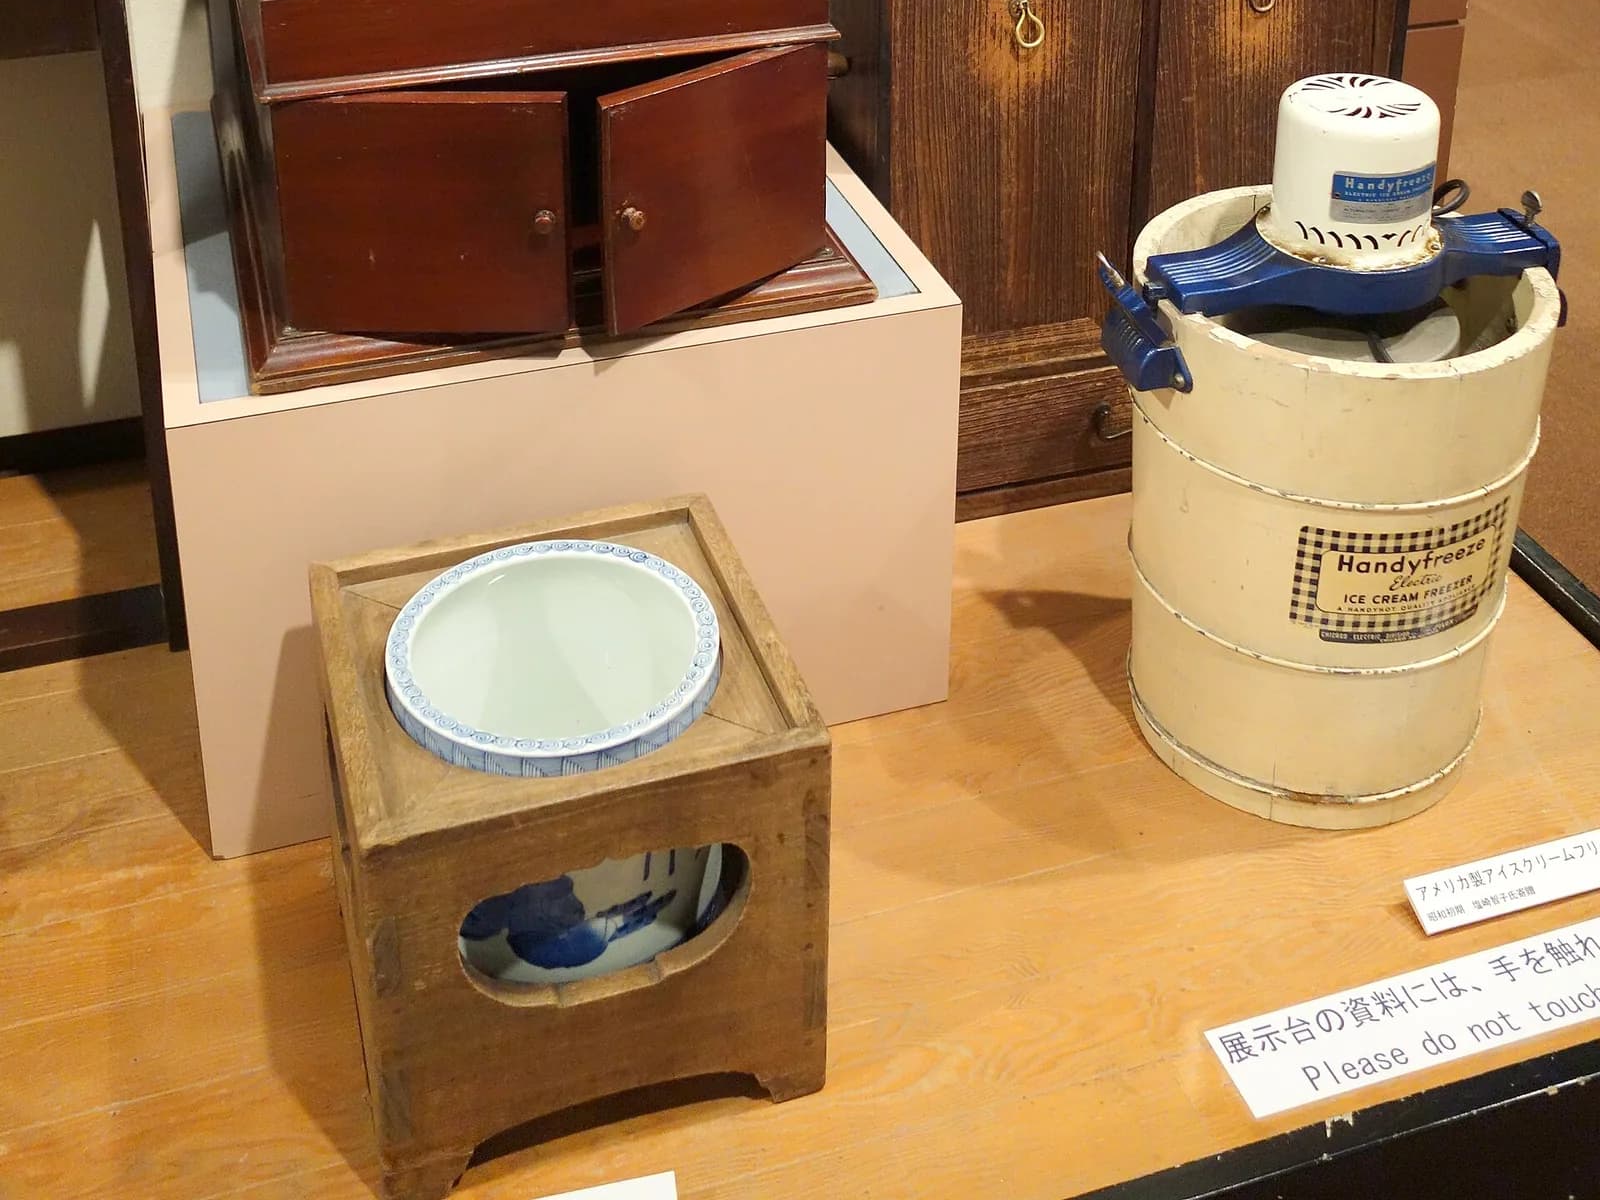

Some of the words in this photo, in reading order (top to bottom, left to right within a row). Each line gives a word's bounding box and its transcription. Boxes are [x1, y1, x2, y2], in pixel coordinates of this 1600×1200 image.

[1344, 172, 1432, 192] Handyfreeze
[1337, 538, 1486, 575] Handyfreeze
[1344, 594, 1366, 604] ICE
[1372, 592, 1419, 604] CREAM
[1424, 574, 1474, 600] FREEZER
[1388, 573, 1442, 592] Electric
[1426, 904, 1466, 922] 昭和初期
[1301, 1044, 1409, 1092] Please
[1421, 1030, 1457, 1056] do
[1467, 1010, 1522, 1043] not
[1528, 983, 1600, 1023] touch
